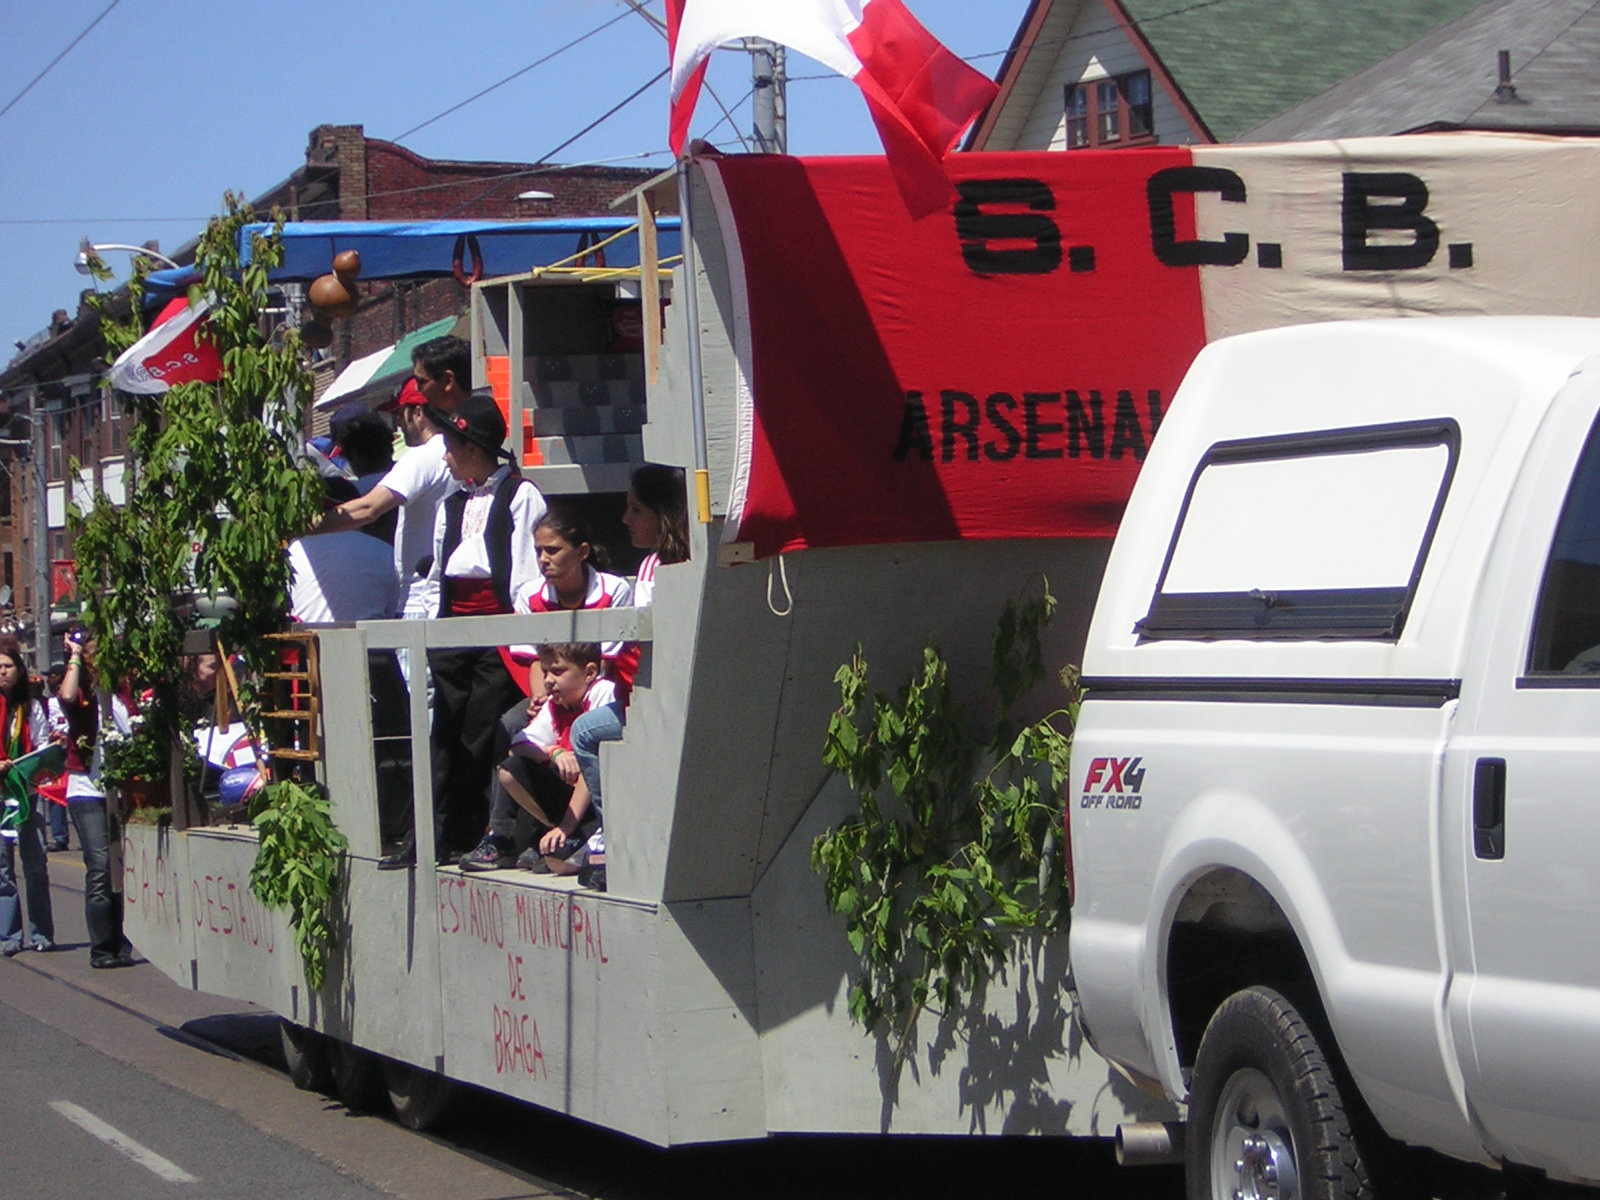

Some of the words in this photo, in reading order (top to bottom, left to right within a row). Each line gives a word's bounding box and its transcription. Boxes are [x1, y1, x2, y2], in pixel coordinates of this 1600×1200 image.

[1083, 757, 1146, 793] FX4
[1080, 795, 1103, 809] OFF
[1105, 795, 1143, 809] ROAD
[507, 952, 526, 1001] DE
[493, 1003, 547, 1081] BRAGA
